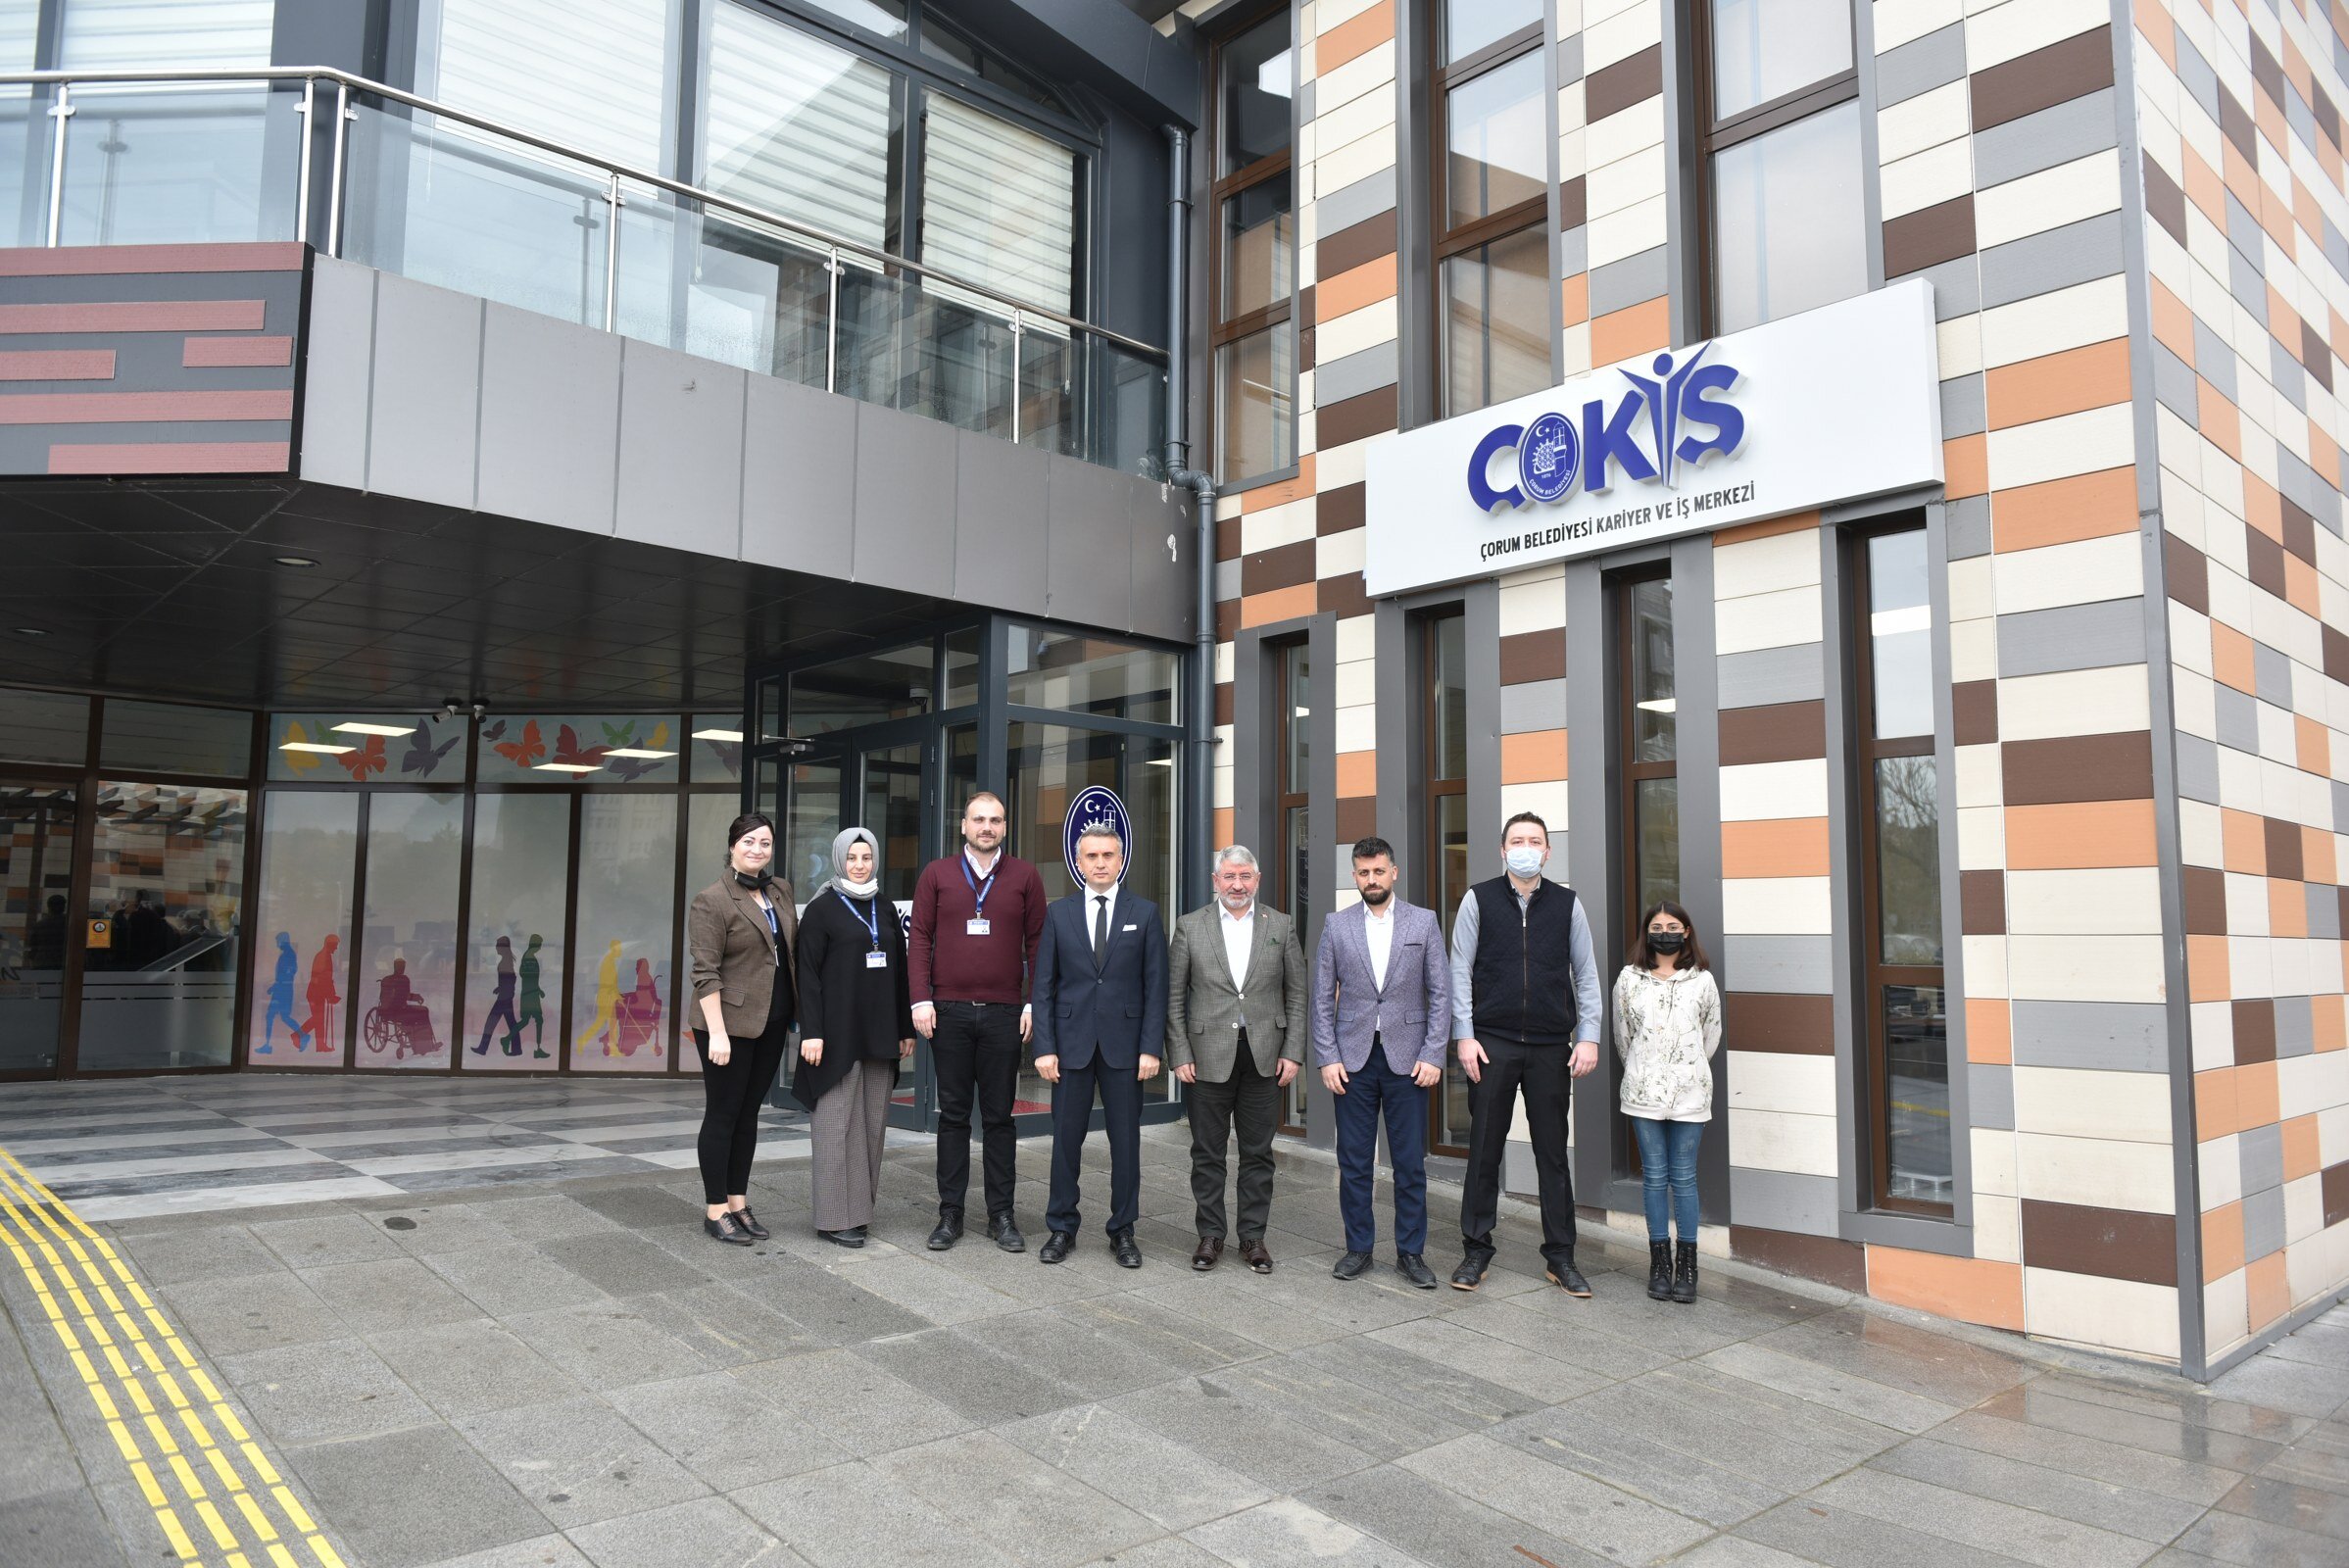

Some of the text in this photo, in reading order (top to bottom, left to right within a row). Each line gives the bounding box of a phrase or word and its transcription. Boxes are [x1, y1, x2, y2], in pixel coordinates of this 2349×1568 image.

[1480, 480, 1755, 563] ÇORUM BELEDİYESİ KARİYER VE İŞ MERKEZİ
